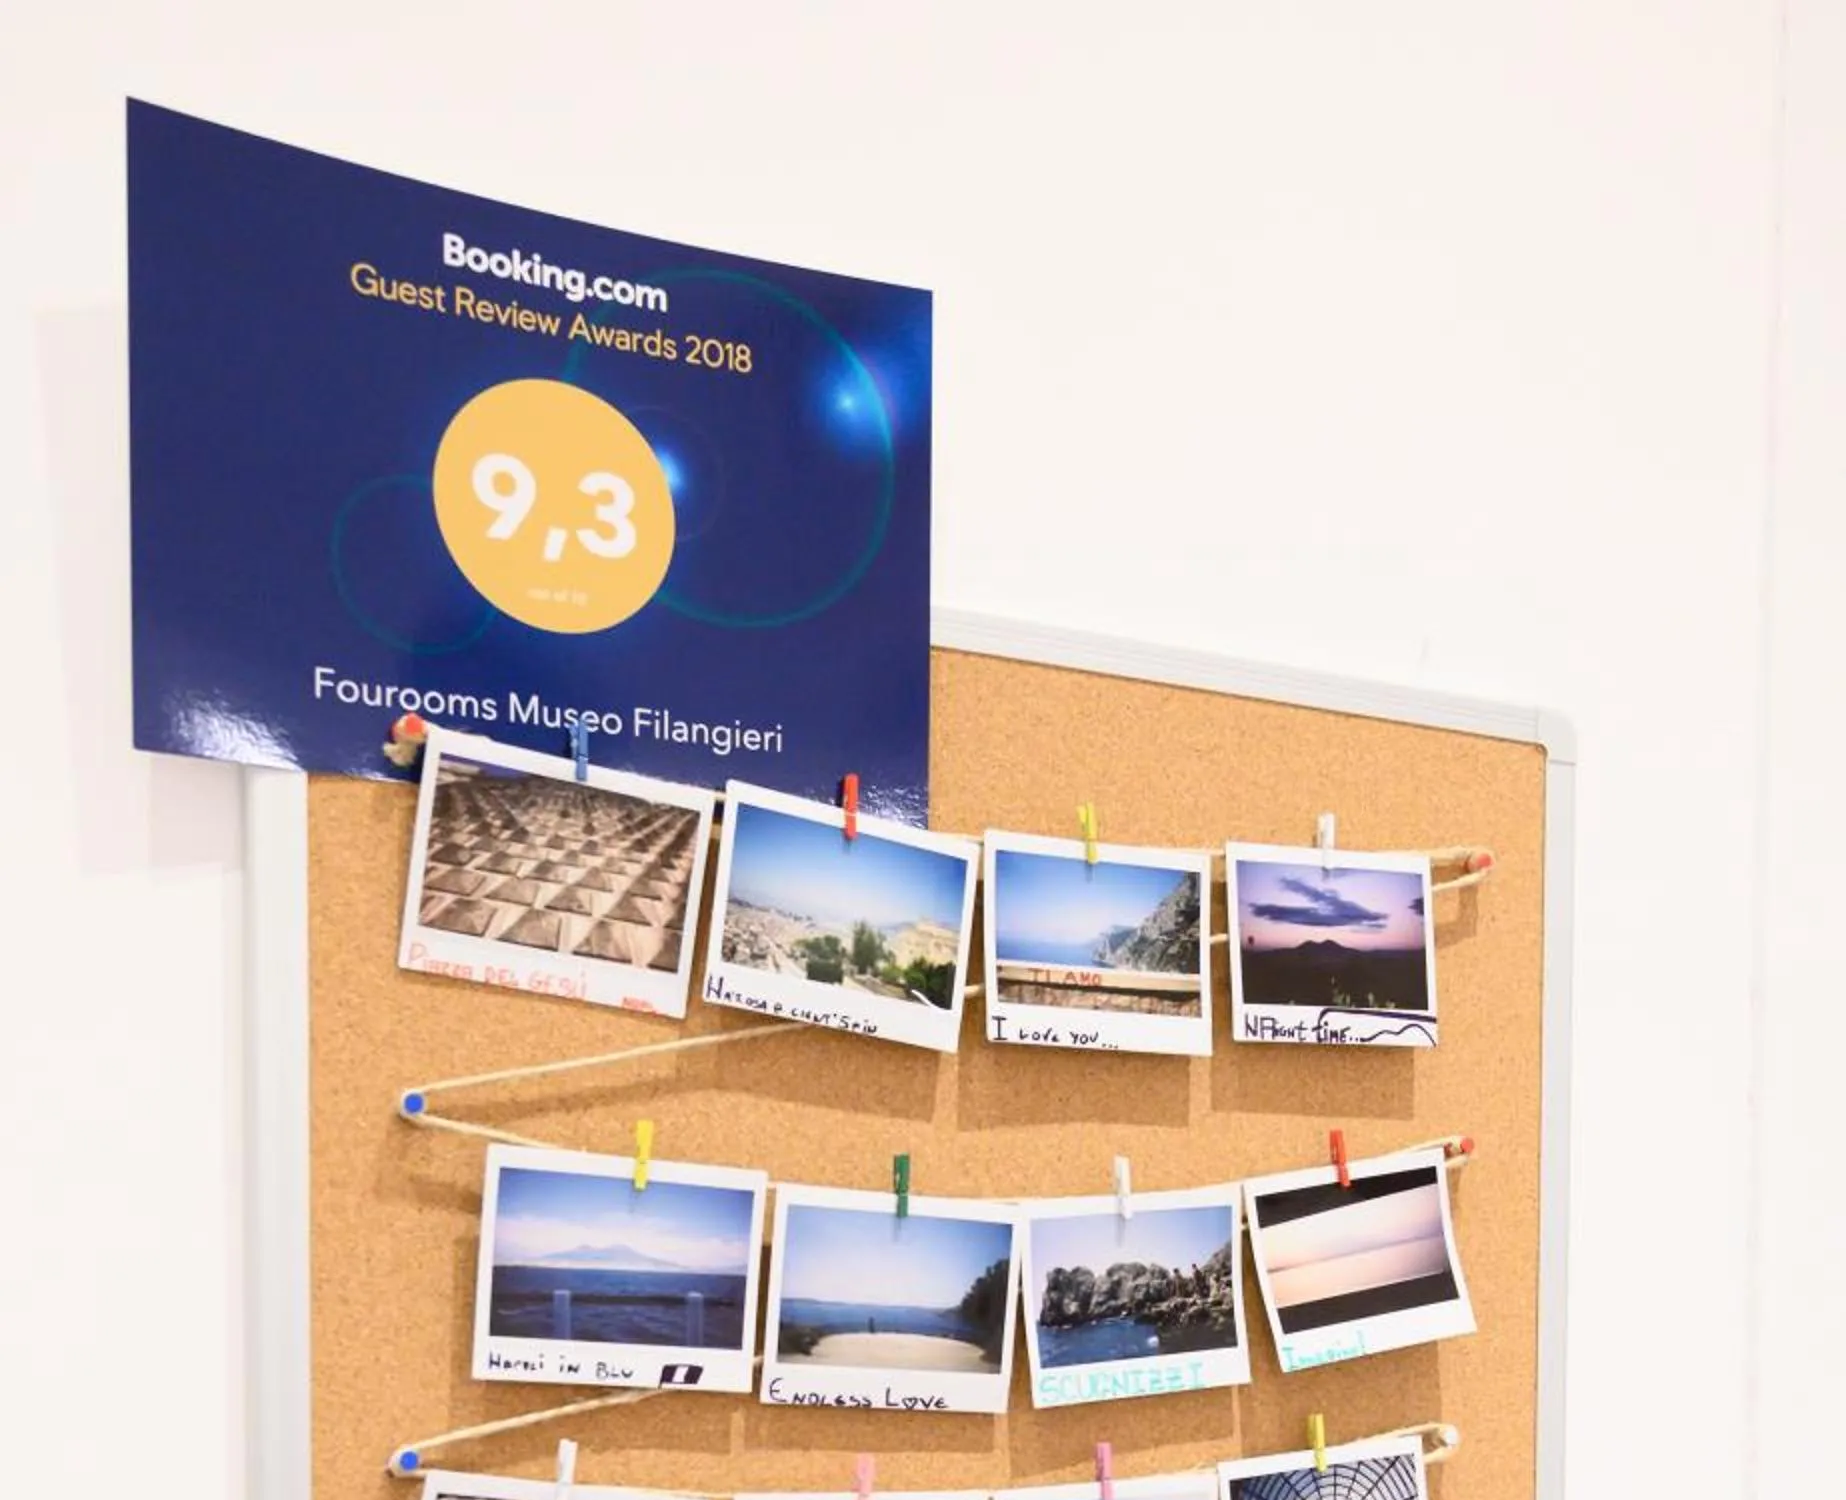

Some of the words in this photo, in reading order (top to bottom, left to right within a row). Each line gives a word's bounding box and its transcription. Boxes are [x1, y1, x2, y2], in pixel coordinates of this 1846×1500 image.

[443, 233, 669, 313] Booking.com
[350, 263, 447, 314] Guest
[454, 287, 562, 337] Review
[569, 313, 678, 362] Awards
[685, 336, 754, 373] 2018
[471, 453, 638, 563] 9,3
[313, 667, 498, 722] Fourooms
[509, 693, 623, 736] Museo
[633, 707, 784, 756] Filangieri
[992, 1015, 1008, 1041] I
